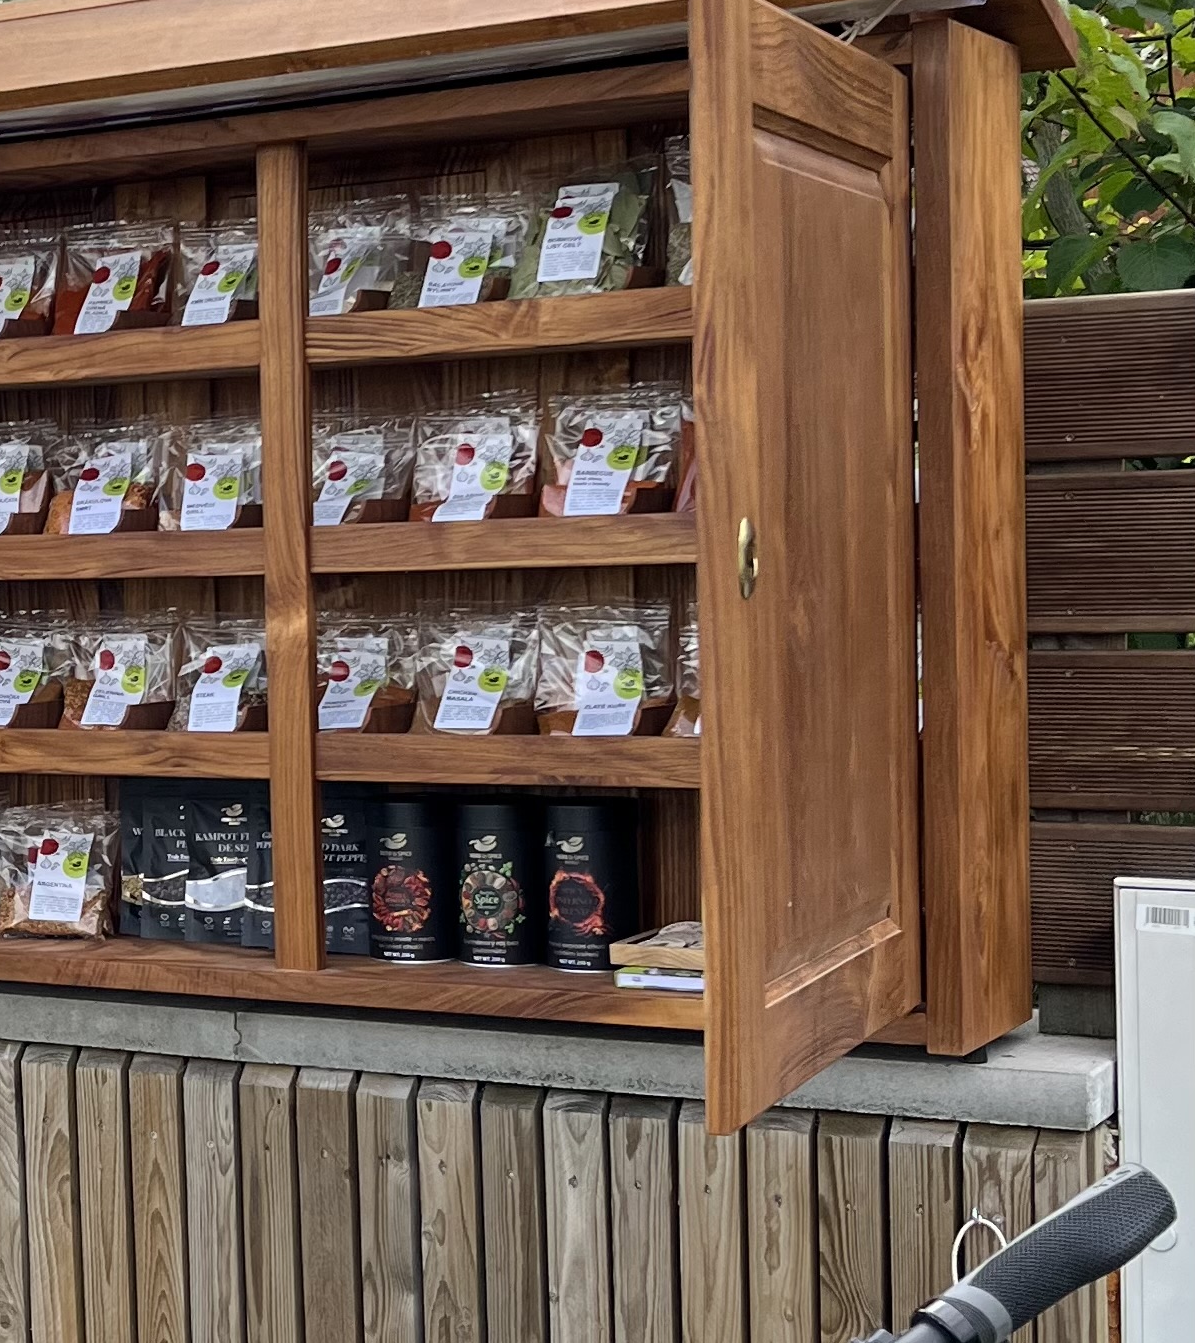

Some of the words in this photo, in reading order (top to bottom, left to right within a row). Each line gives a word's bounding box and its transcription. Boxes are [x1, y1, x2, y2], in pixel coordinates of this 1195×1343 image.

[154, 827, 186, 837] BLACK
[194, 832, 237, 842] KAMPOT
[331, 842, 360, 852] DARK
[36, 880, 73, 889] ARGENTINA
[473, 893, 500, 907] Spice
